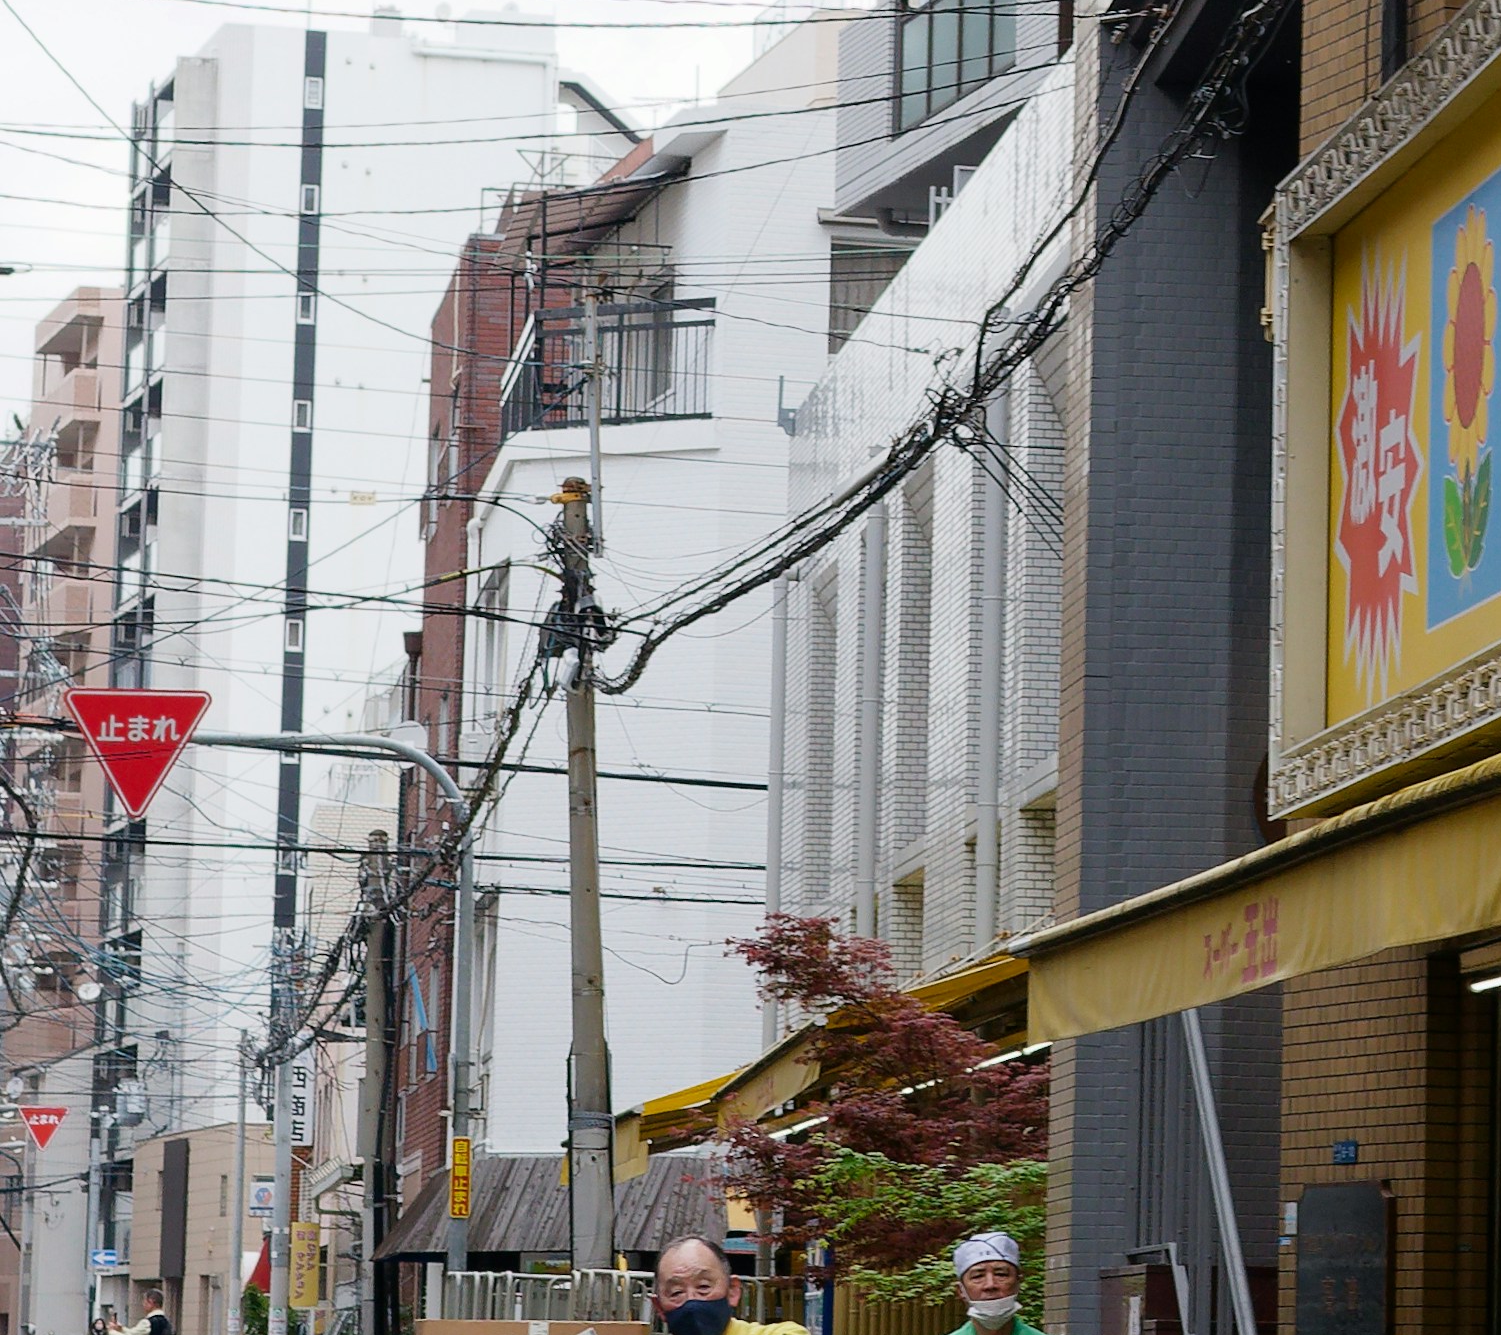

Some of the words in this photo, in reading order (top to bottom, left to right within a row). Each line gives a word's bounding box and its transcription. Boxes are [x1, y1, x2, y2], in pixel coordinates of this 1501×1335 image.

[1350, 358, 1407, 579] 激安
[96, 714, 181, 742] 止まれ
